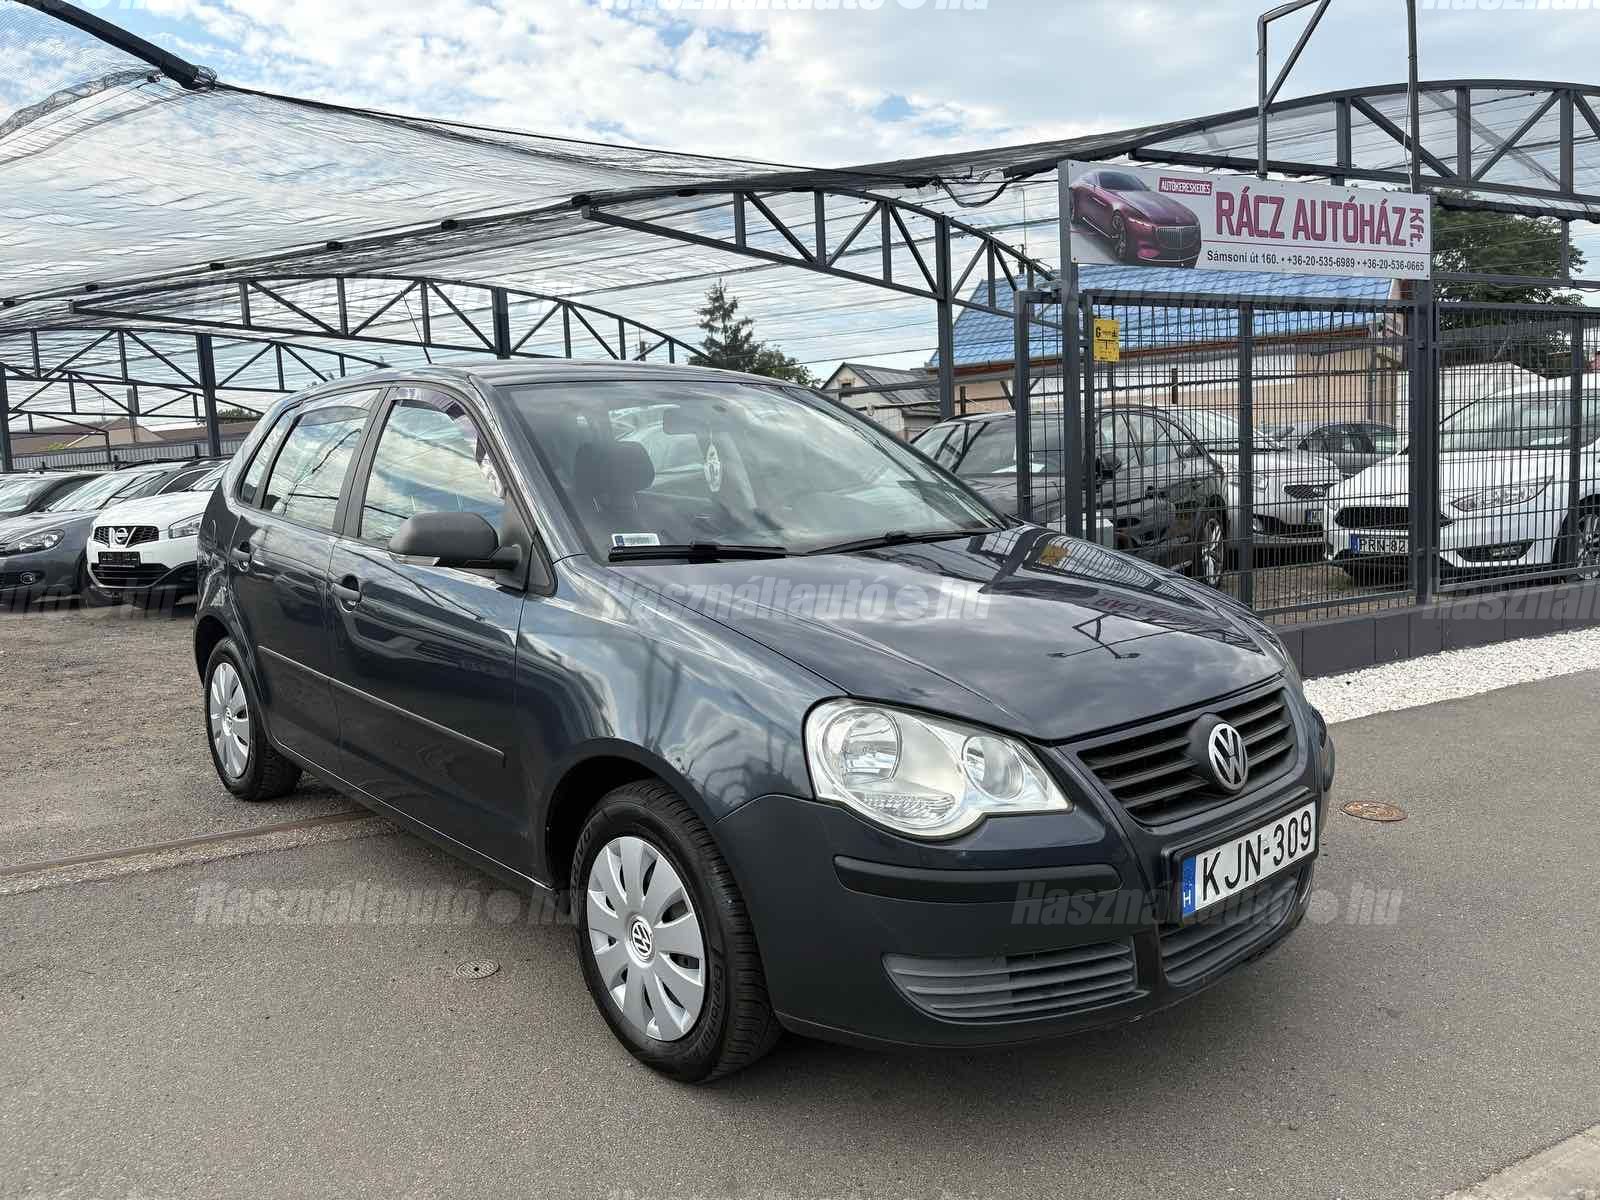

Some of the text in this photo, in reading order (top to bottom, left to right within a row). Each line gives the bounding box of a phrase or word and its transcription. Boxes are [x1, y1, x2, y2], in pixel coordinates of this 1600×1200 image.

[1216, 186, 1406, 247] RÁCZ AUTÓHÁZ
[1410, 208, 1424, 247] Kft.
[1207, 250, 1247, 262] Sámsoni
[1250, 252, 1259, 264] út
[1262, 254, 1279, 265] 160.
[1203, 810, 1312, 901] KJN-309
[1183, 889, 1191, 907] H
